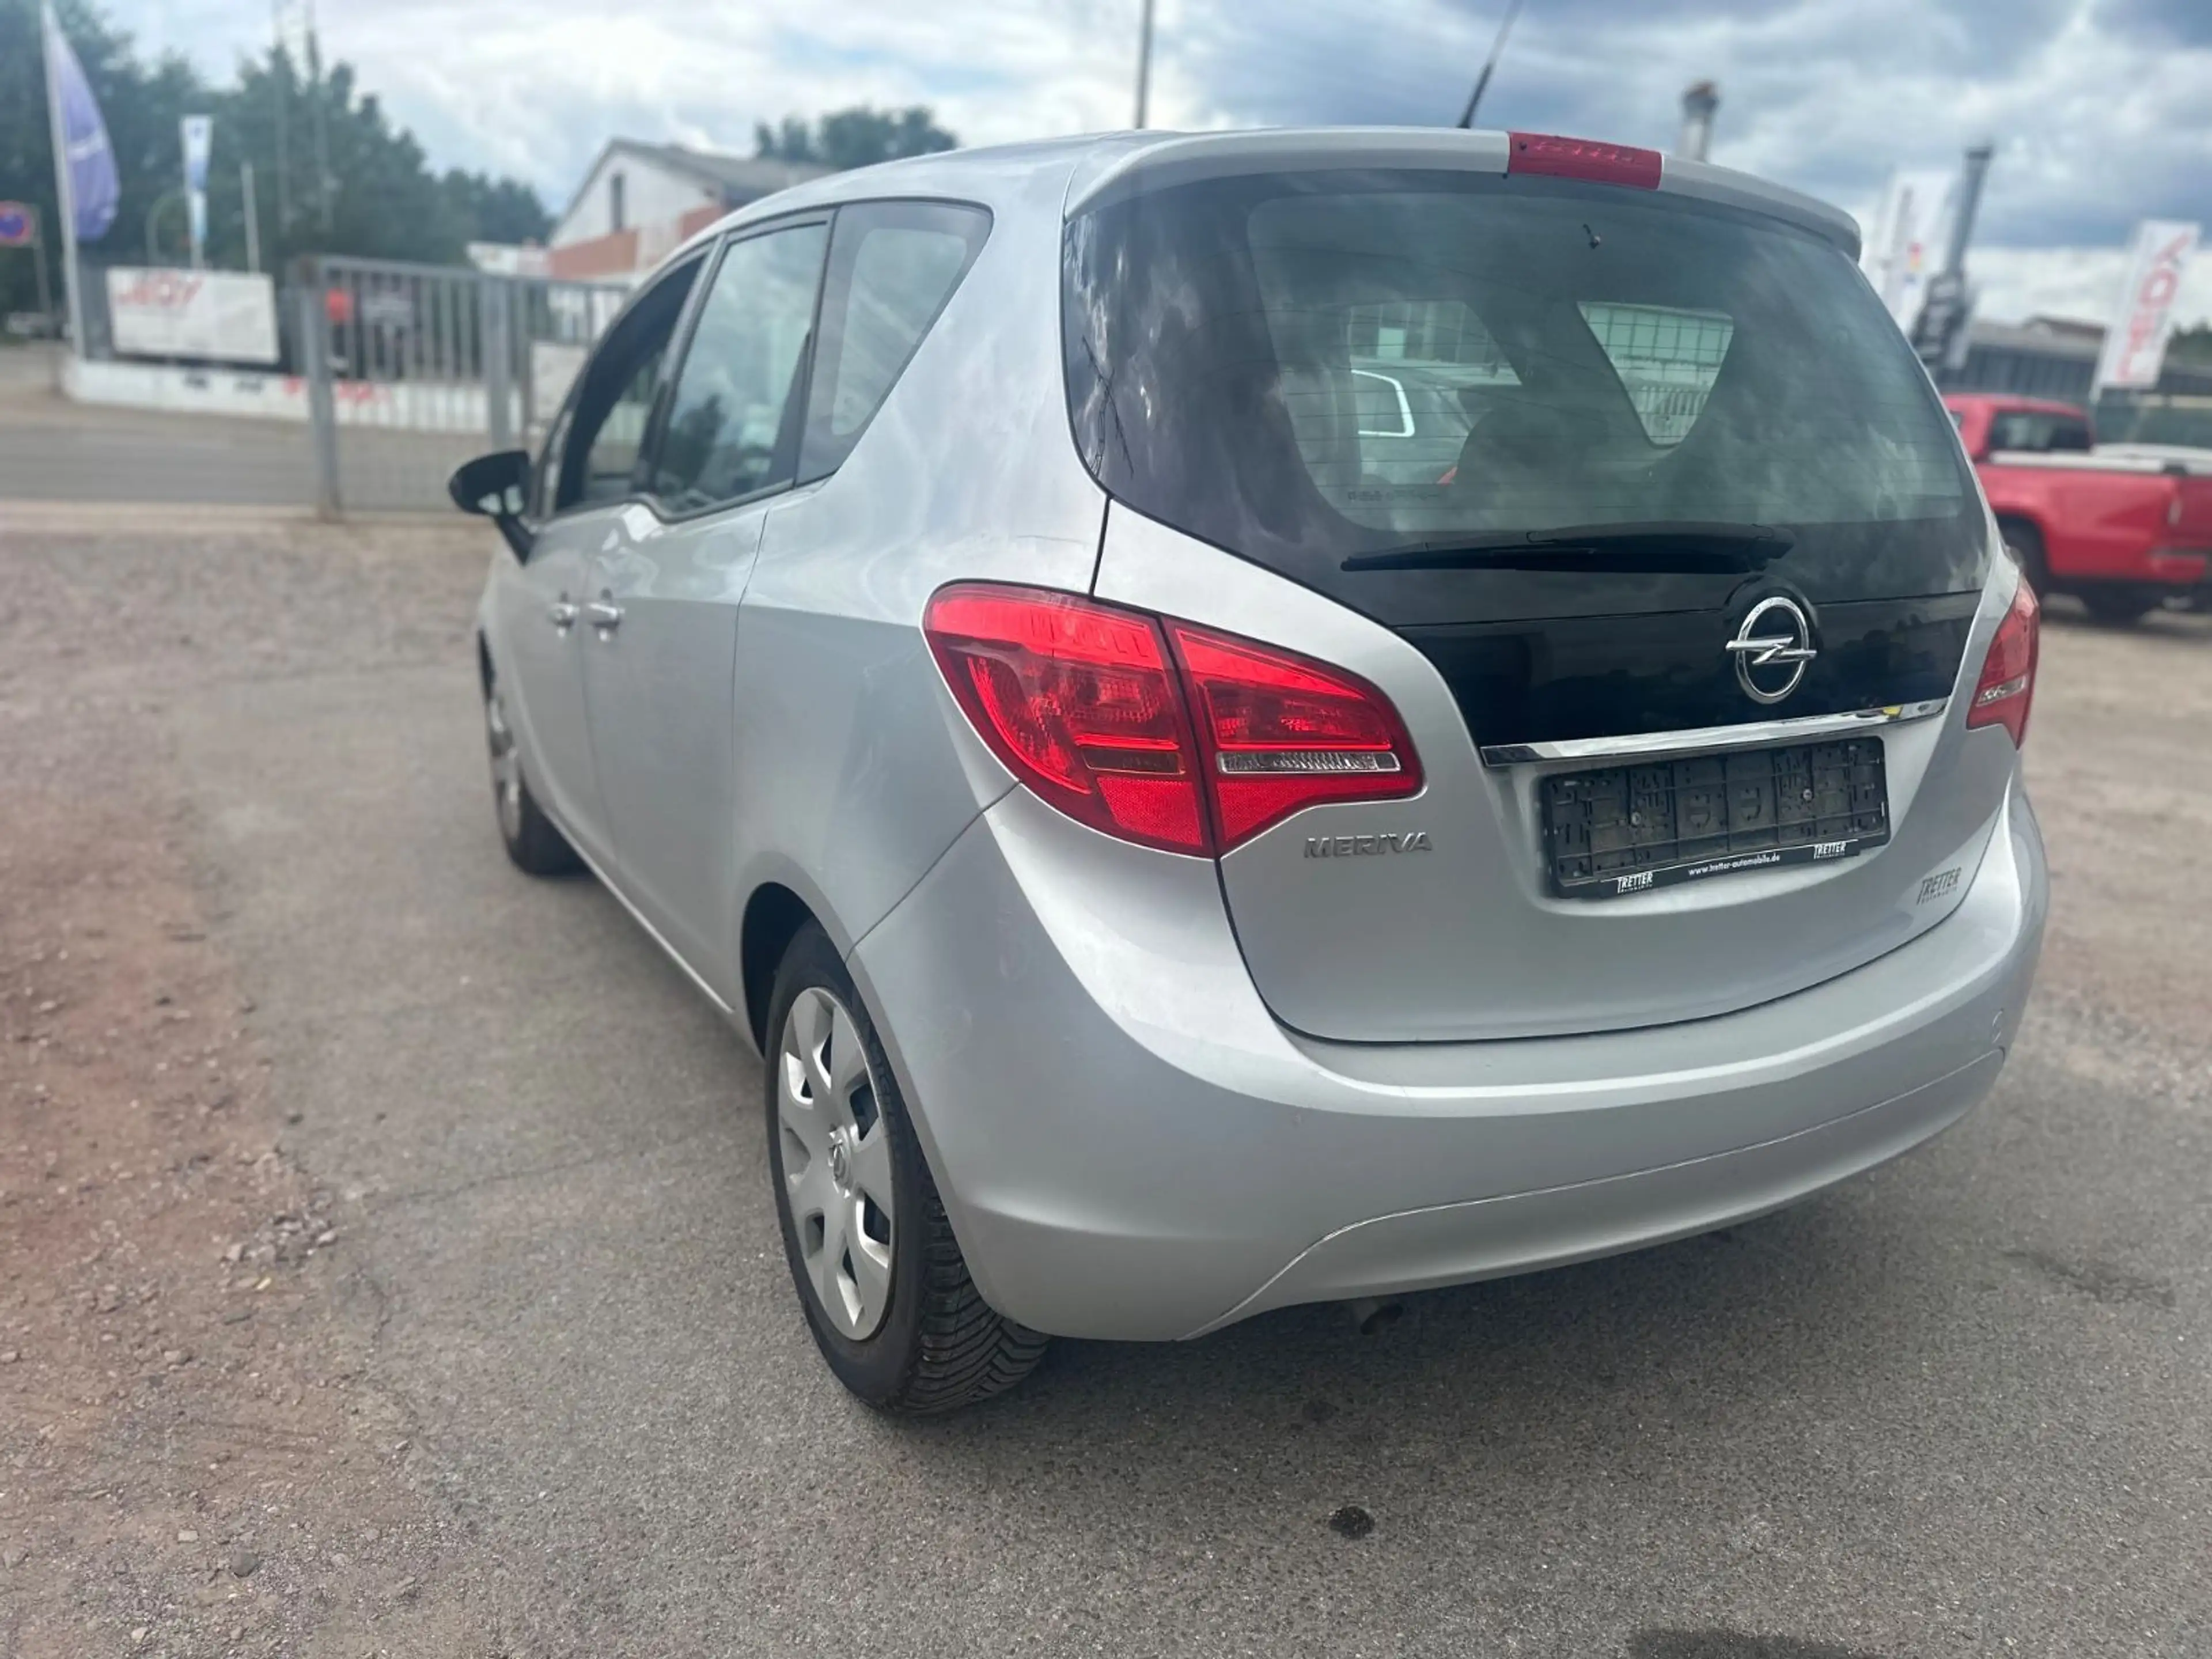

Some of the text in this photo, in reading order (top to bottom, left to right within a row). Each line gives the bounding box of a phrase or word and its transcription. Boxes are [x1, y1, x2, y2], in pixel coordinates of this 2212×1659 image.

[1304, 832, 1433, 858] MERIVA
[1814, 841, 1847, 859] TRETTER
[1618, 872, 1653, 893] TRETTER
[1916, 866, 1962, 905] TRETTER
